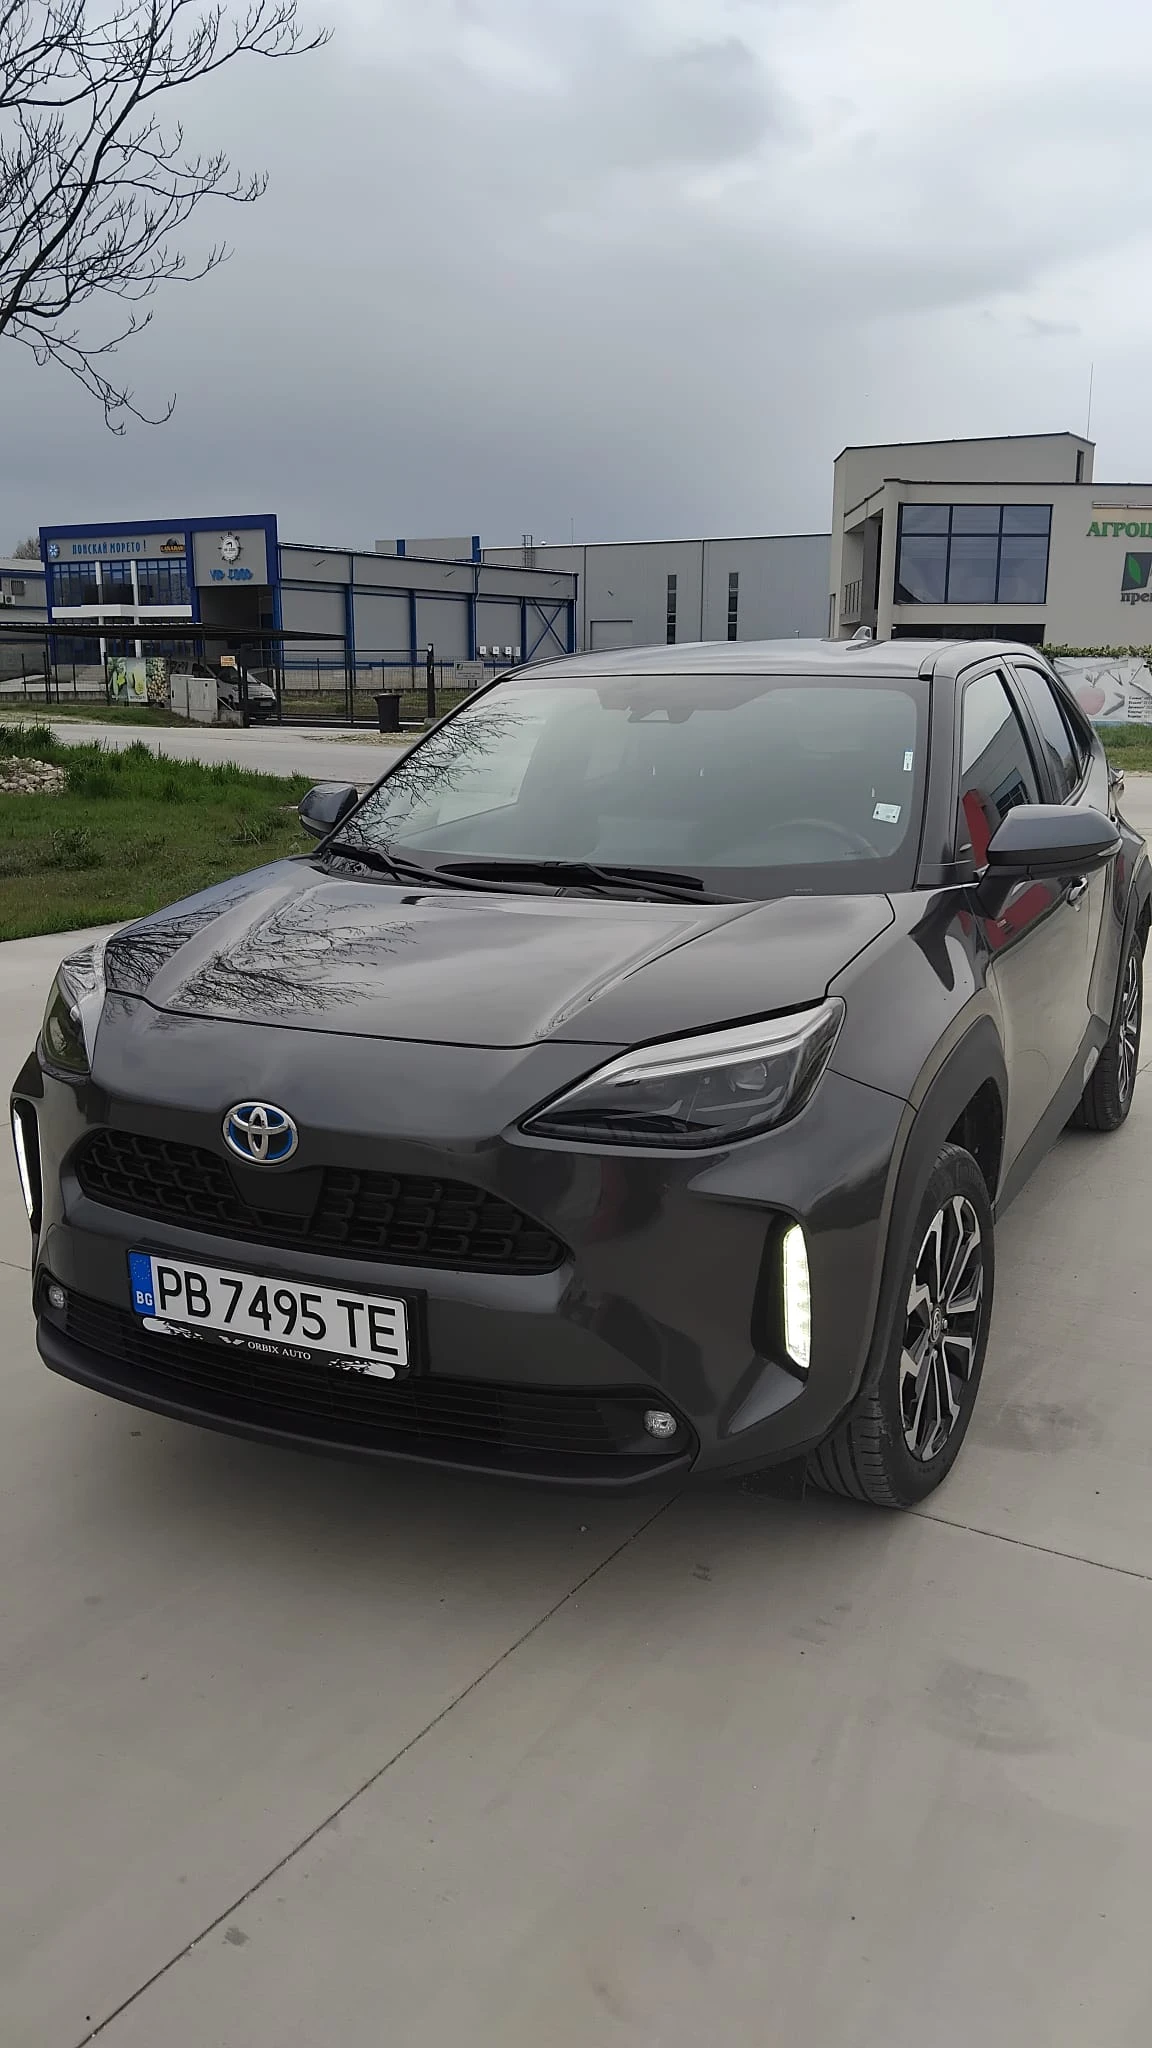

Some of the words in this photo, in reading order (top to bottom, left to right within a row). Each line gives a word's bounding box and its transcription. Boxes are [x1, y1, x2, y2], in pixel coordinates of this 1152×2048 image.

[1120, 592, 1152, 605] пре
[136, 1290, 153, 1306] BG
[156, 1265, 211, 1318] PB
[219, 1277, 327, 1341] 7495
[337, 1298, 399, 1356] TE
[247, 1341, 279, 1354] ORBIX
[282, 1348, 311, 1360] AUTO
